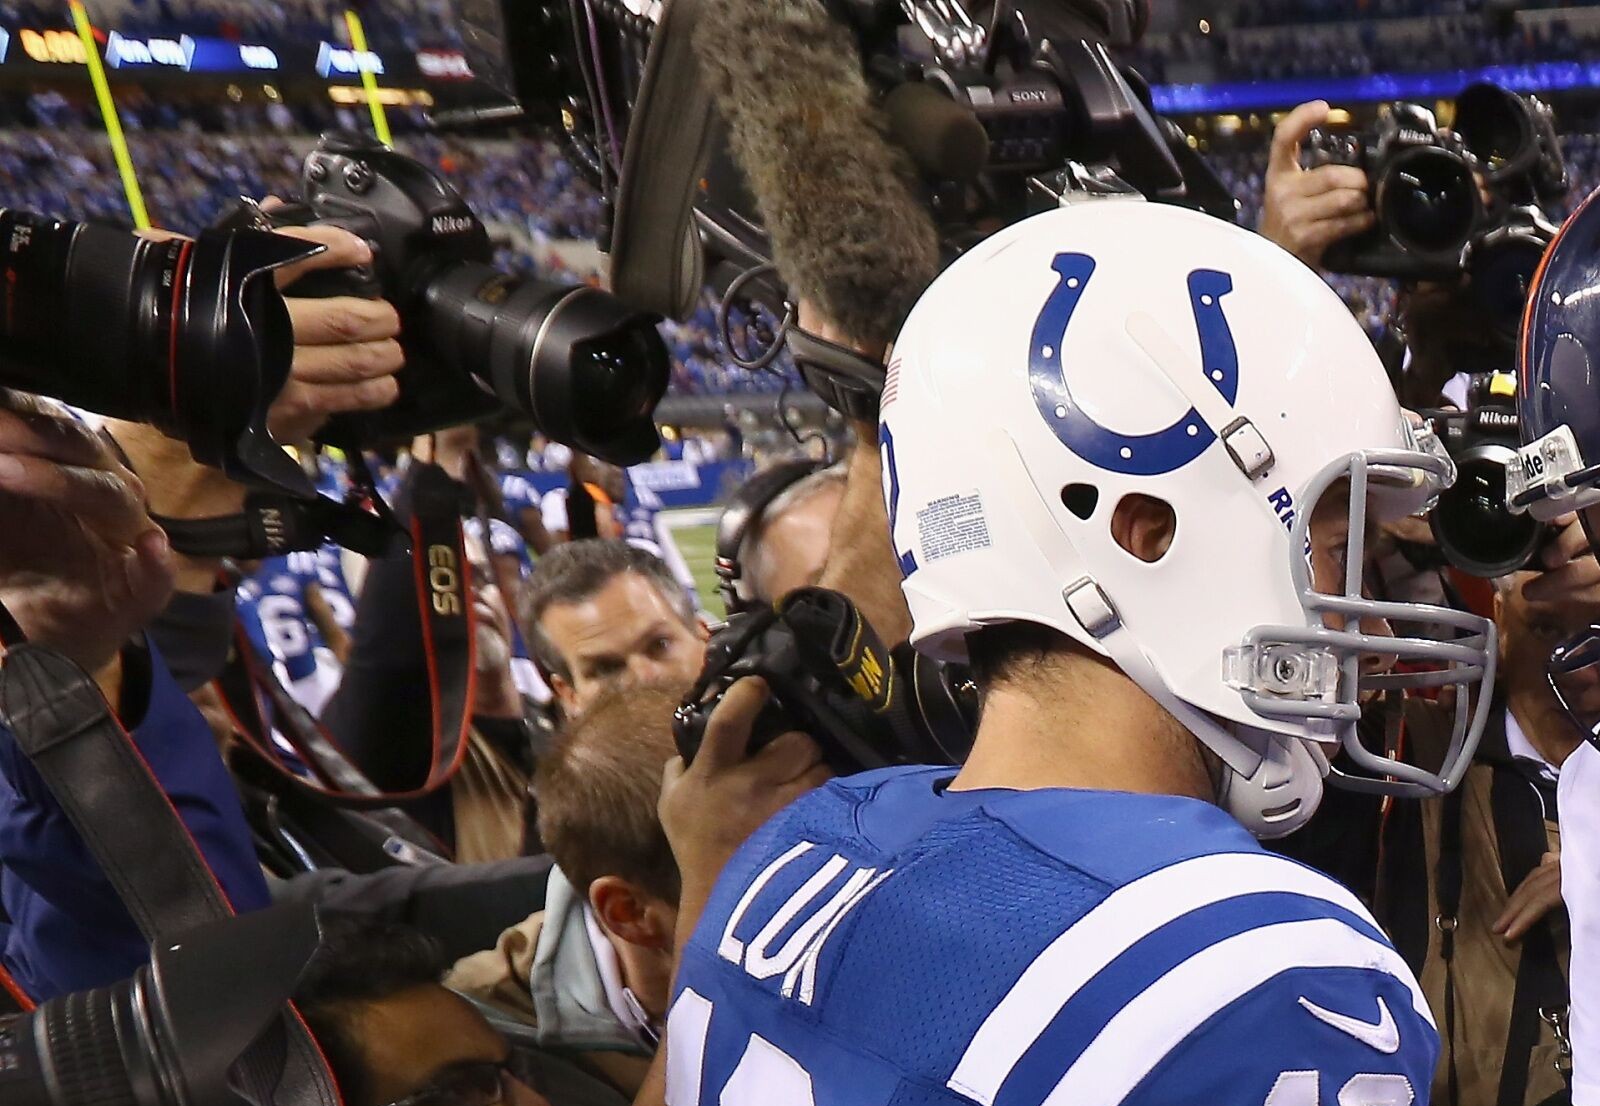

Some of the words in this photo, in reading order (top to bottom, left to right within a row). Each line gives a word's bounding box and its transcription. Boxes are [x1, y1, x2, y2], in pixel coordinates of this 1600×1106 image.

[1011, 90, 1046, 102] SONY
[1400, 130, 1434, 143] Nikon
[432, 216, 471, 234] Nikon
[1479, 411, 1518, 424] Nikon
[259, 507, 285, 547] NIK
[427, 544, 462, 616] EOS
